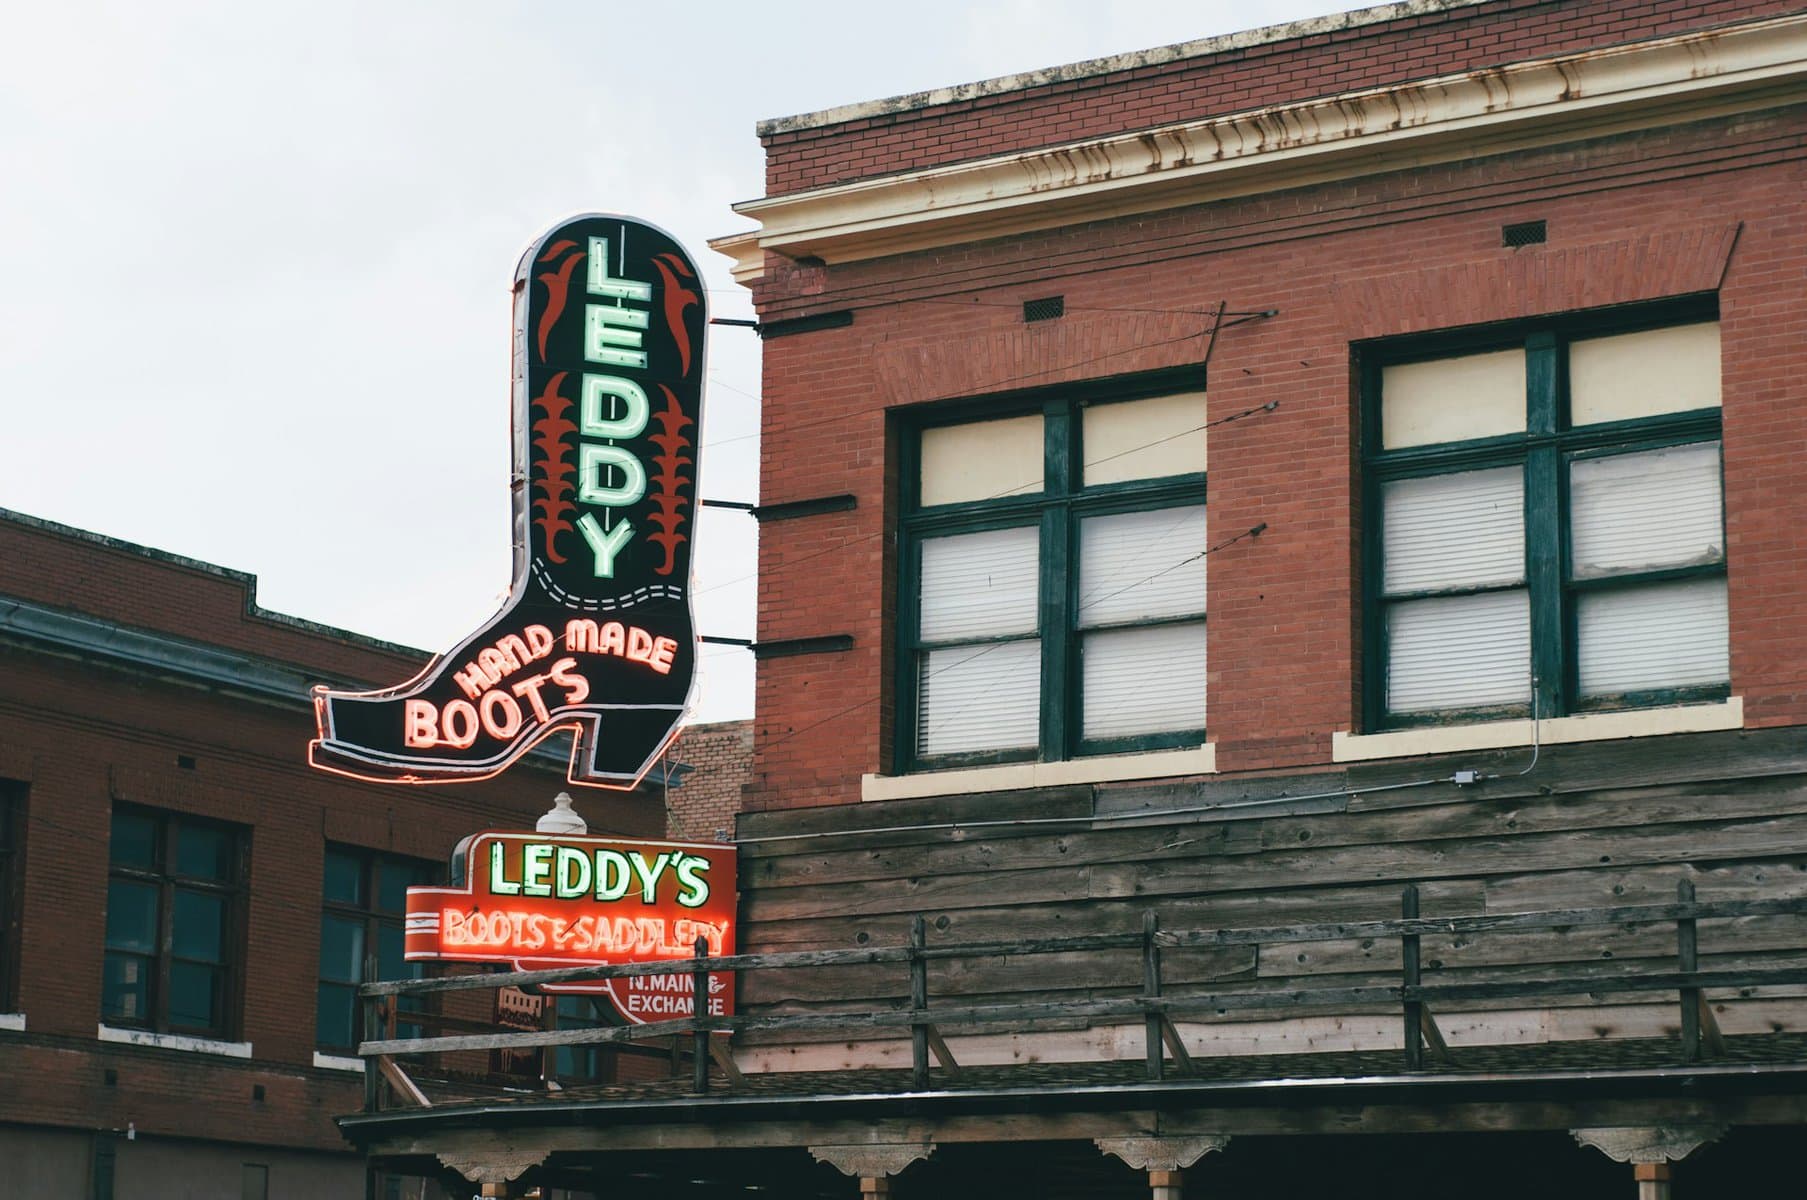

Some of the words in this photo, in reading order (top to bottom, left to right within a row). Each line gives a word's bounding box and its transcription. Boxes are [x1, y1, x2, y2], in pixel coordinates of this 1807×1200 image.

[576, 235, 652, 579] LEDDY
[453, 624, 554, 698] HAND
[565, 618, 678, 675] MADE
[404, 657, 590, 748] BOOTS
[490, 840, 711, 907] LEDDY'S
[443, 908, 545, 949] BOOTS
[573, 915, 728, 956] SADDLERY
[628, 994, 724, 1016] EXCHANE
